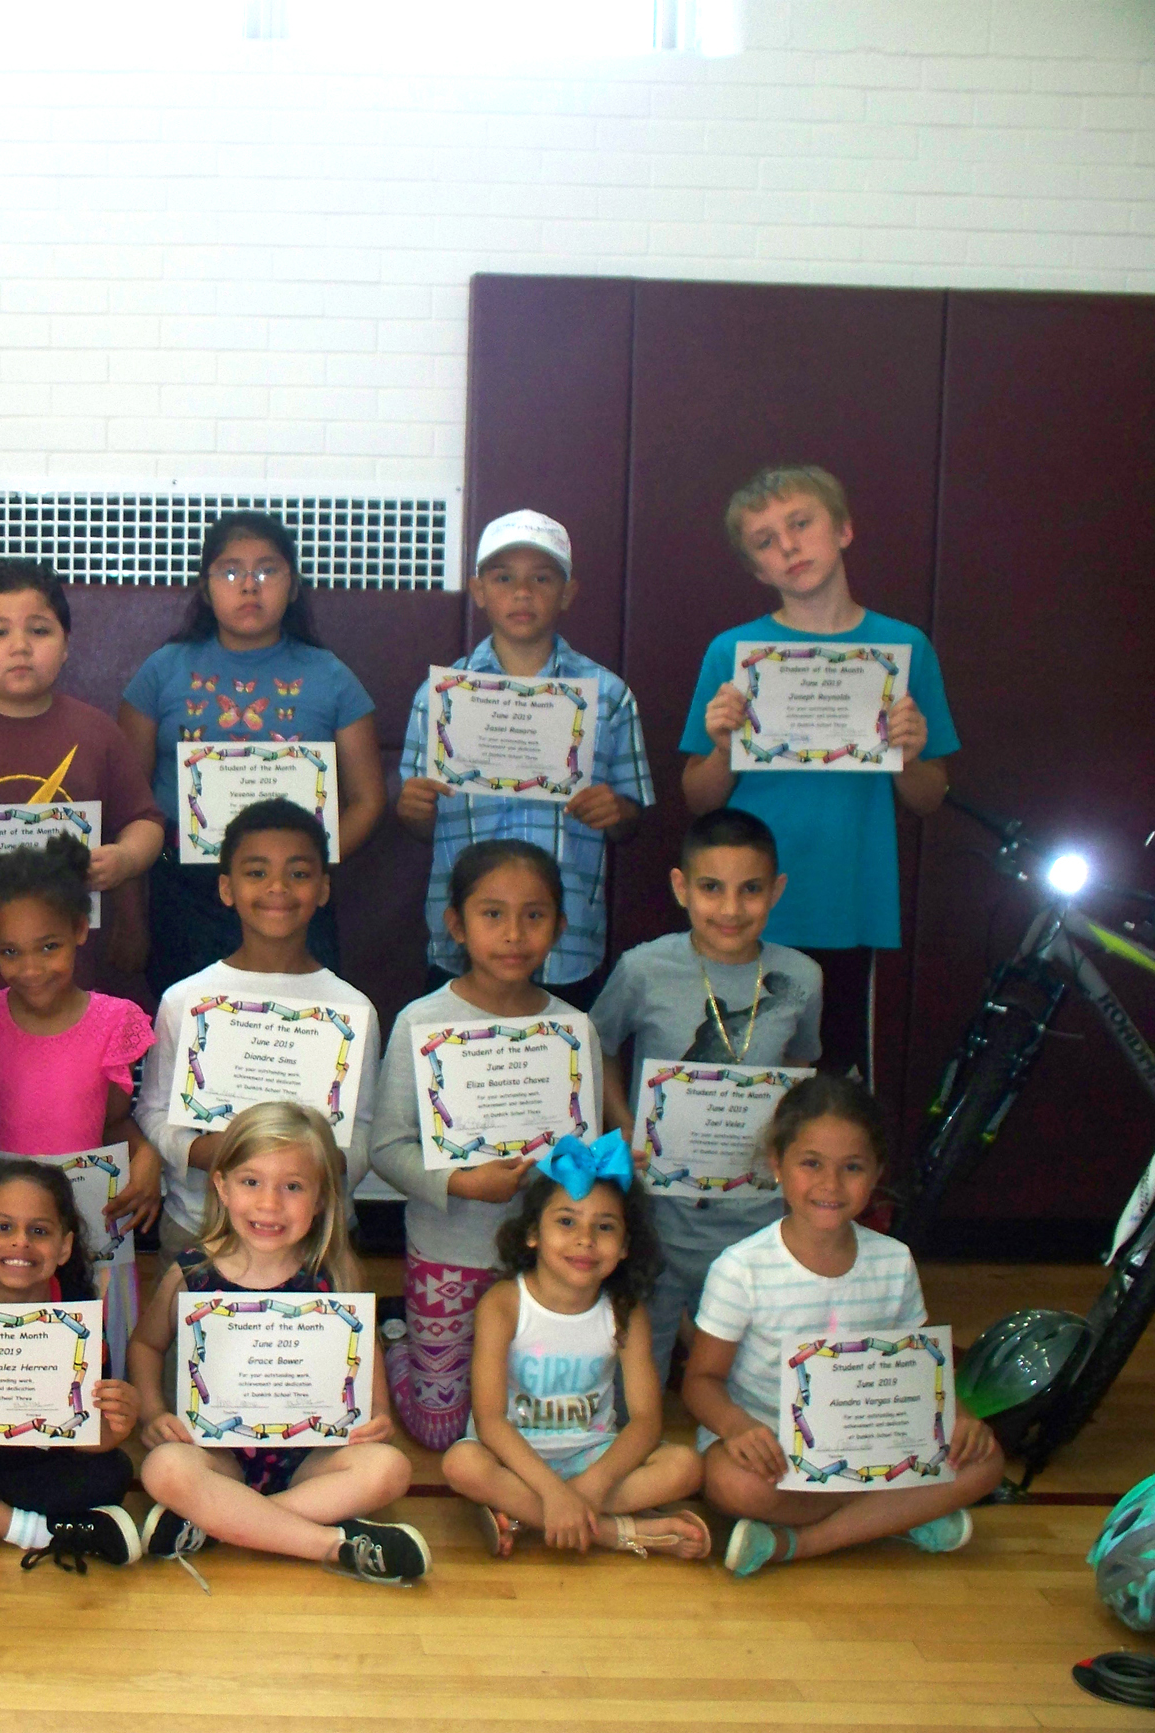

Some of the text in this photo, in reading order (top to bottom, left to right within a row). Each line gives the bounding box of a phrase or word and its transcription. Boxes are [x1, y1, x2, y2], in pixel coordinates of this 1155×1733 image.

[229, 1018, 261, 1028] Student
[277, 1024, 290, 1032] the
[293, 1026, 318, 1035] Month
[250, 1036, 294, 1048] June 2019
[461, 1048, 492, 1057] Student
[495, 1046, 504, 1054] of
[524, 1043, 548, 1052] Month
[277, 1056, 296, 1064] Sims
[486, 1060, 528, 1071] June 2019
[466, 1076, 549, 1089] Eliza Bautista Chavez
[227, 1322, 324, 1331] Student of the Month
[0, 1331, 15, 1339] the
[19, 1331, 48, 1339] Month
[252, 1339, 300, 1348] June 2019
[247, 1356, 303, 1364] Grace Bower
[831, 1362, 864, 1372] Student
[866, 1360, 876, 1370] of
[894, 1359, 916, 1368] Month
[856, 1377, 897, 1388] June 2019
